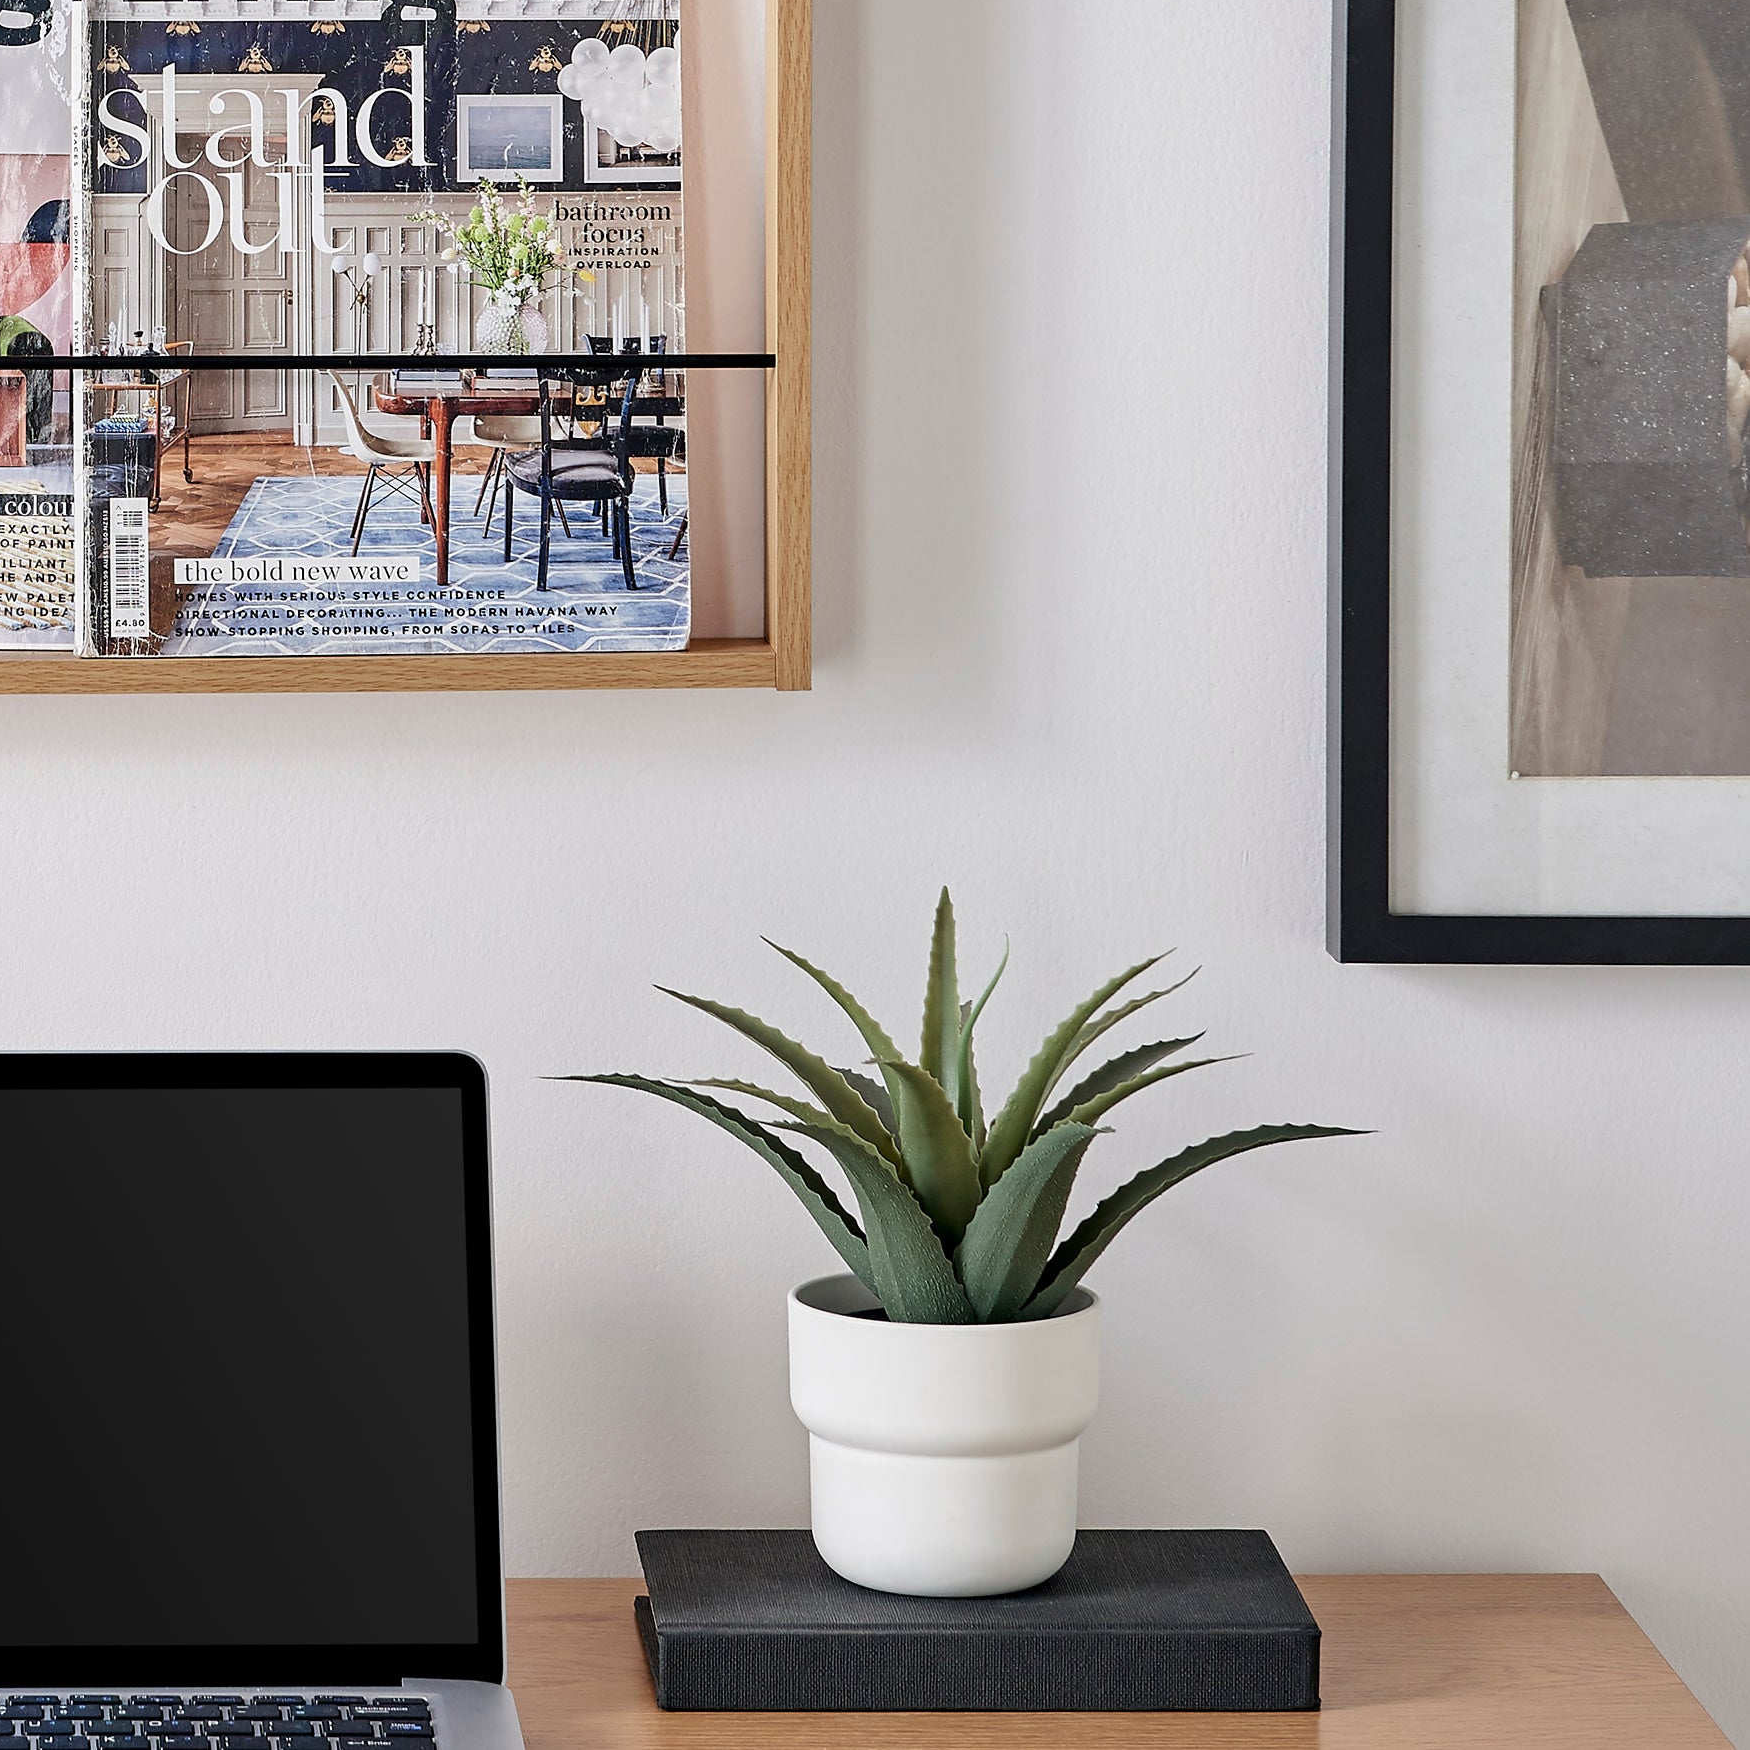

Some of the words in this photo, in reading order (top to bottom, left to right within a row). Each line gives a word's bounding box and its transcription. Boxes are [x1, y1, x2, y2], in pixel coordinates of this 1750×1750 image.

[97, 45, 438, 169] stand
[147, 144, 350, 255] out
[555, 200, 671, 221] bathroom
[583, 222, 645, 243] focus
[569, 247, 659, 256] INSPIRATION
[576, 260, 652, 269] OVERLOAD
[0, 538, 20, 548] OF
[29, 539, 75, 549] PAINT
[184, 560, 223, 582] the
[231, 560, 283, 581] bold
[293, 564, 340, 581] new
[348, 564, 409, 580] wave
[24, 573, 57, 583] AND
[174, 592, 227, 602] HOMES
[234, 592, 273, 601] WITH
[280, 591, 346, 601] SERIOUS
[352, 591, 400, 601] STYLE
[406, 590, 505, 600] CONFIDENCE
[175, 609, 280, 620] DIRECTIONAL
[286, 608, 402, 619] DECORATING...
[409, 608, 438, 618] THE
[444, 607, 508, 617] MODERN
[515, 606, 578, 616] HAVANA
[585, 606, 618, 616] WAY
[115, 619, 145, 627] £4.80
[175, 626, 305, 637] SHOW-STOPPING
[312, 625, 395, 636] SHOPPING,
[402, 625, 444, 635] FROM
[450, 625, 500, 635] SOFAS
[507, 625, 525, 634] TO
[533, 624, 575, 634] TILES
